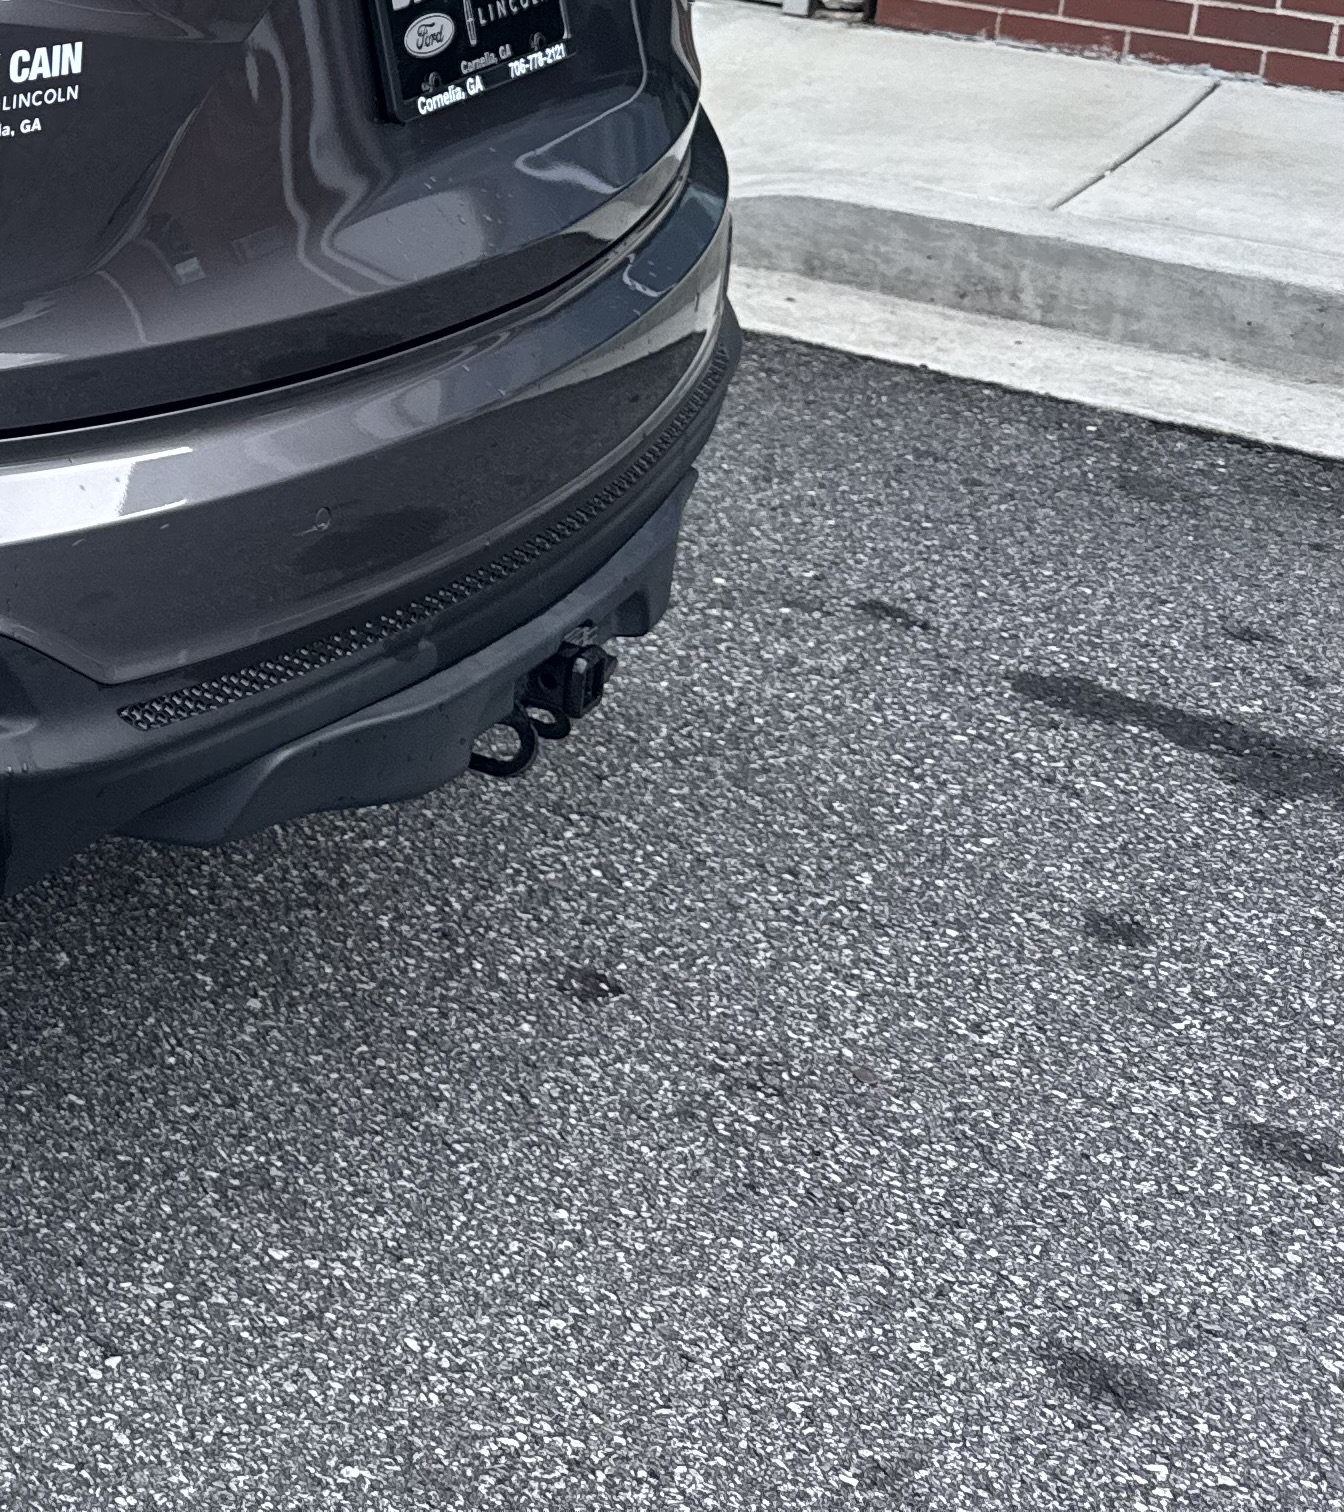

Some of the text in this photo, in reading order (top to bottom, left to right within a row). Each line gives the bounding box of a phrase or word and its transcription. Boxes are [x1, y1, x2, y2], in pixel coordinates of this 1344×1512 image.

[9, 41, 83, 83] CAIN
[498, 44, 512, 59] GA
[2, 85, 79, 111] LINCOLN
[417, 85, 466, 115] Cornelia,
[466, 75, 485, 96] GA
[20, 117, 42, 133] GA
